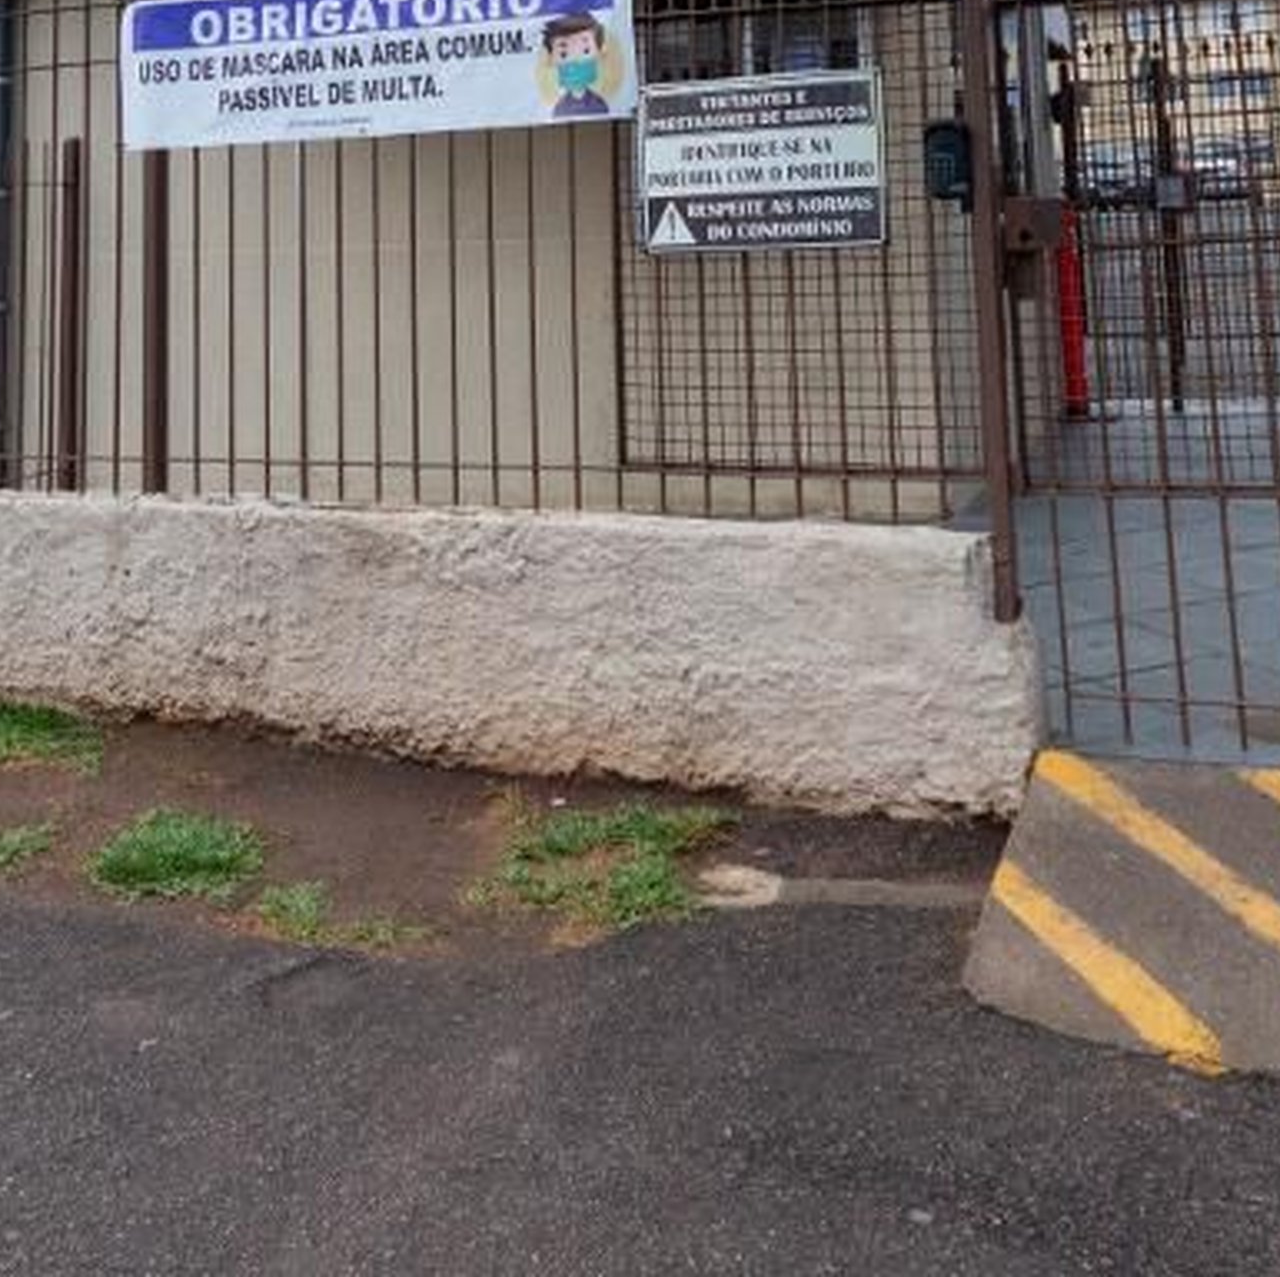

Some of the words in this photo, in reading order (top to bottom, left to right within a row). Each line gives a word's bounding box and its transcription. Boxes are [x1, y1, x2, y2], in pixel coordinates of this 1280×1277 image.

[138, 59, 181, 85] USO
[188, 57, 216, 81] DE
[332, 45, 364, 70] NA
[437, 29, 532, 61] COMUM.
[218, 79, 321, 114] PASSÍVEL
[328, 81, 355, 104] DE
[361, 75, 444, 102] MULTA.
[760, 109, 781, 124] DE
[769, 165, 783, 181] O
[786, 161, 875, 181] PORTEIRO
[687, 200, 764, 218] RESPEITE
[770, 198, 793, 215] AS
[796, 194, 873, 214] NORMAS
[707, 224, 733, 242] DO
[737, 217, 853, 239] CONDOMÍNIO
